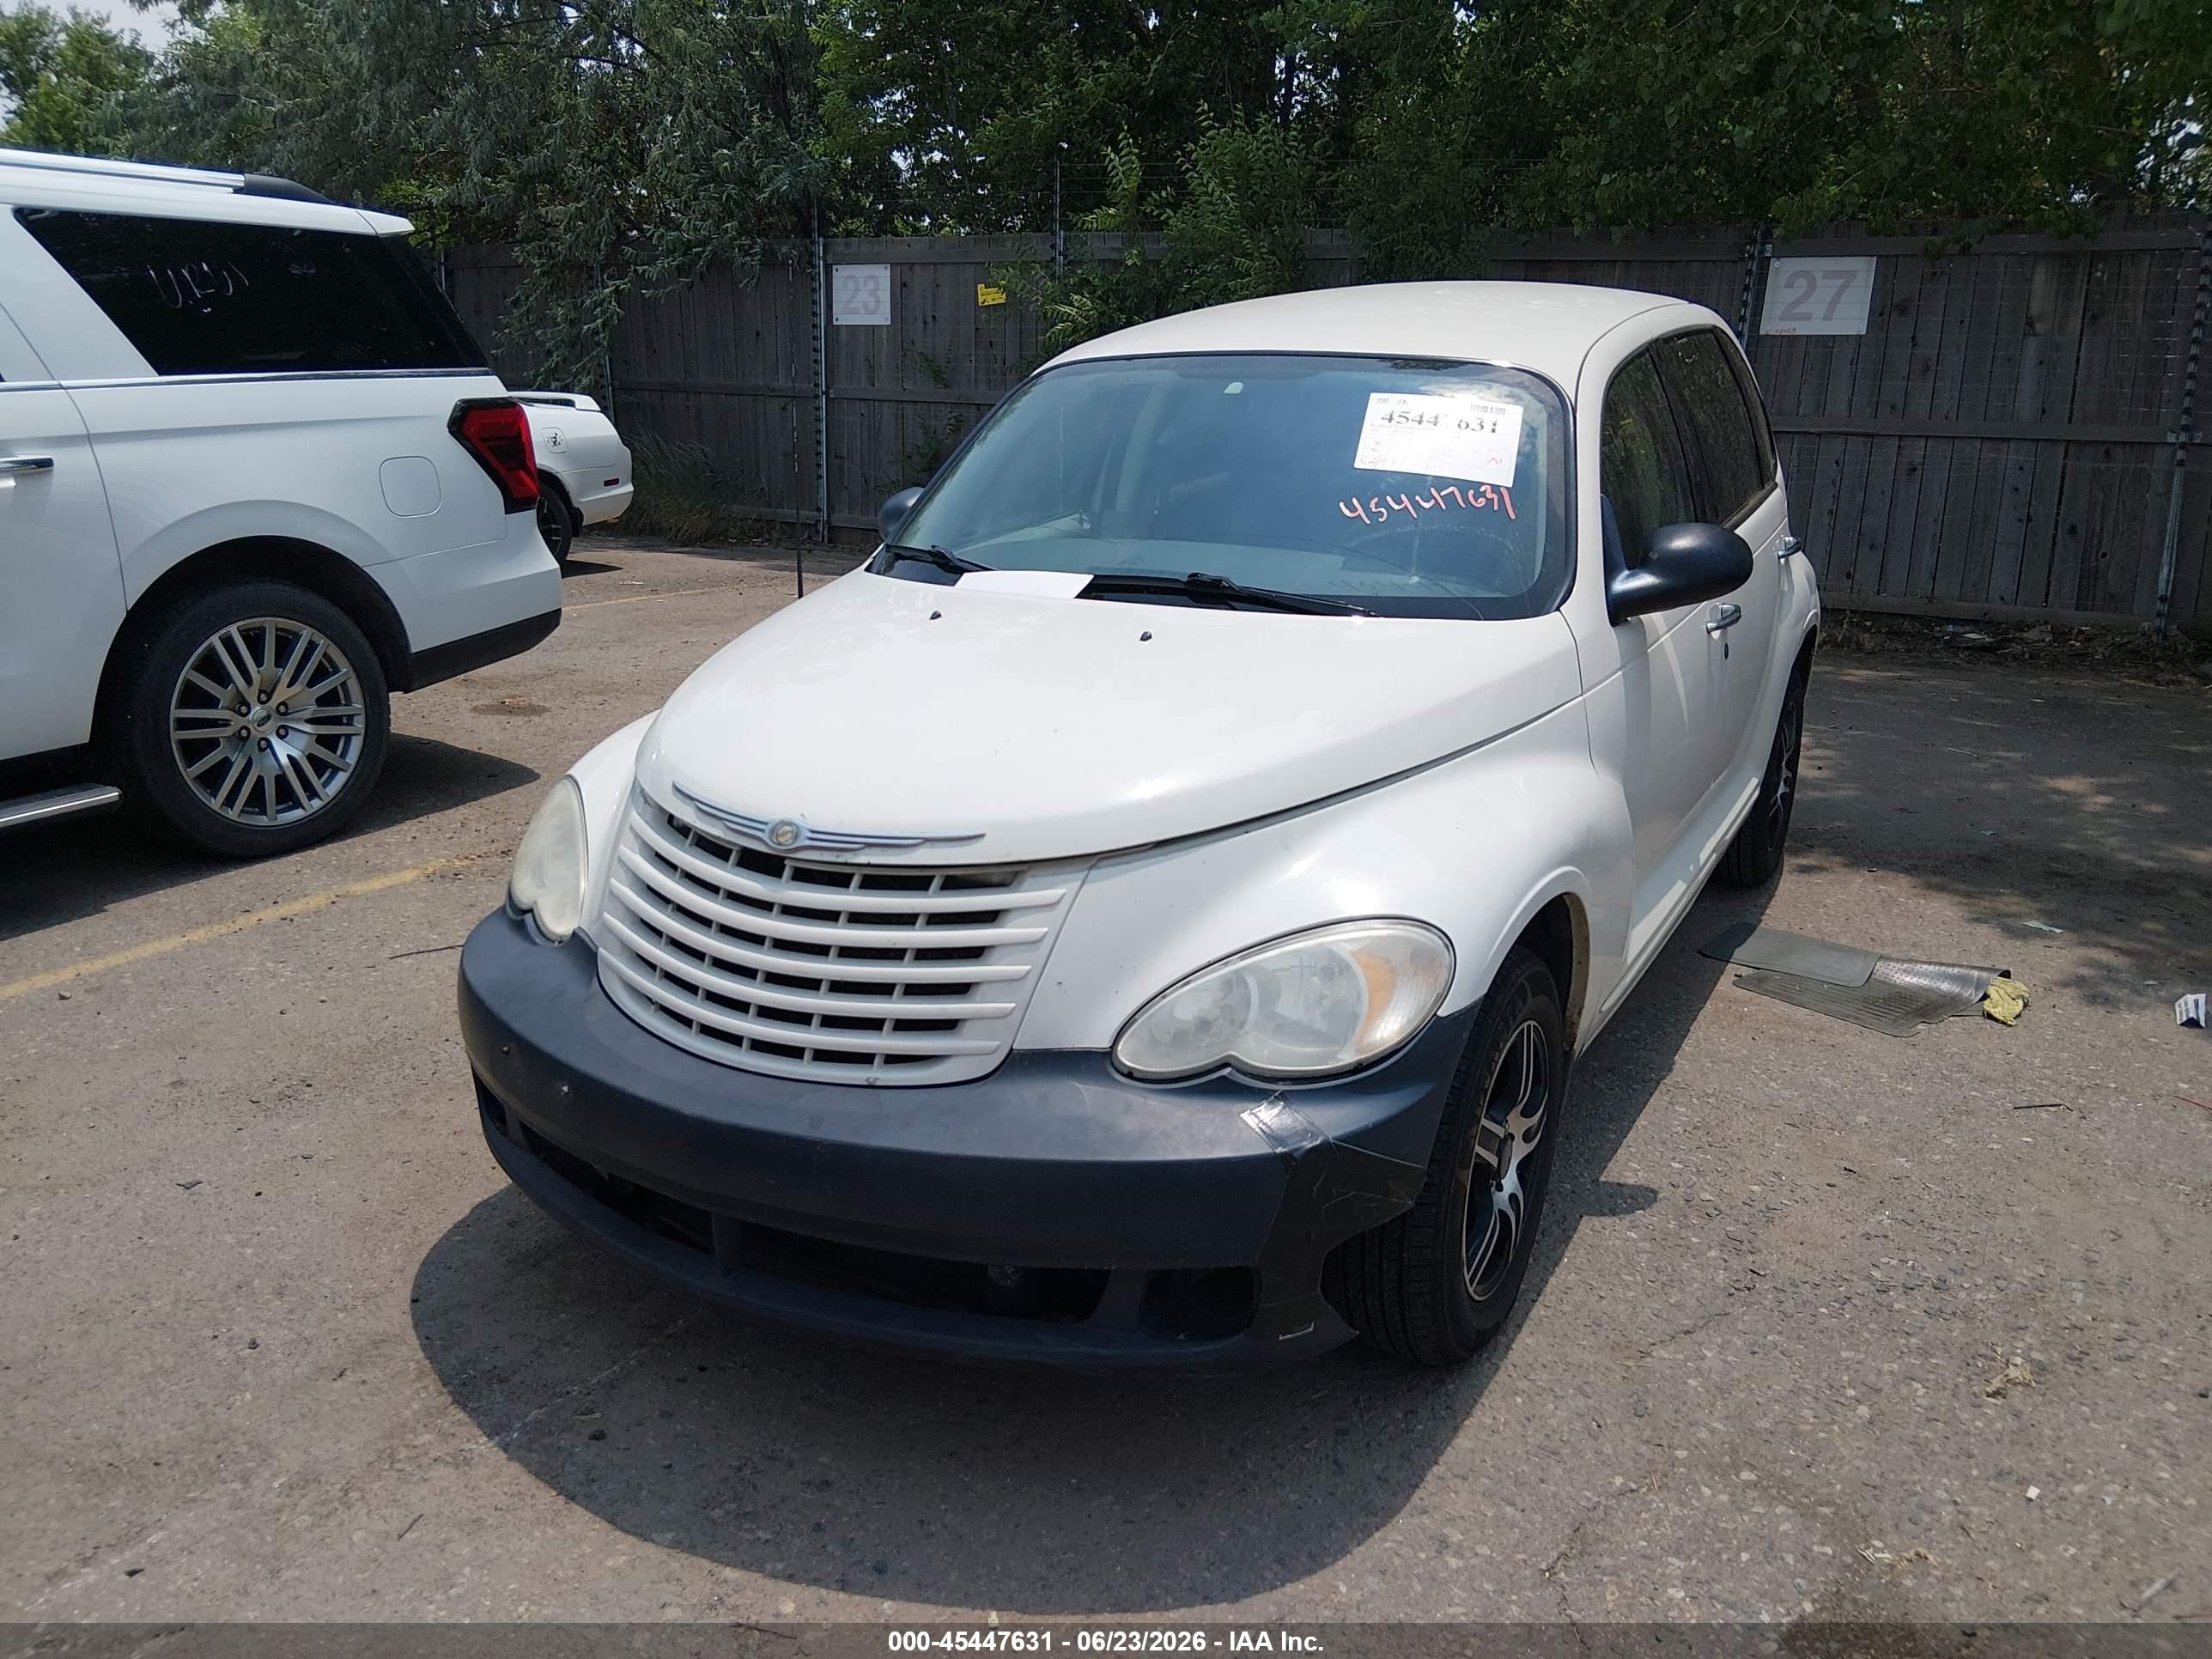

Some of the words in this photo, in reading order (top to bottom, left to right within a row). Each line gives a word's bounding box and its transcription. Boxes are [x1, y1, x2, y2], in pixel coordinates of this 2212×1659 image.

[842, 274, 881, 315] 23
[1778, 270, 1857, 322] 27
[1339, 484, 1516, 525] 45447631
